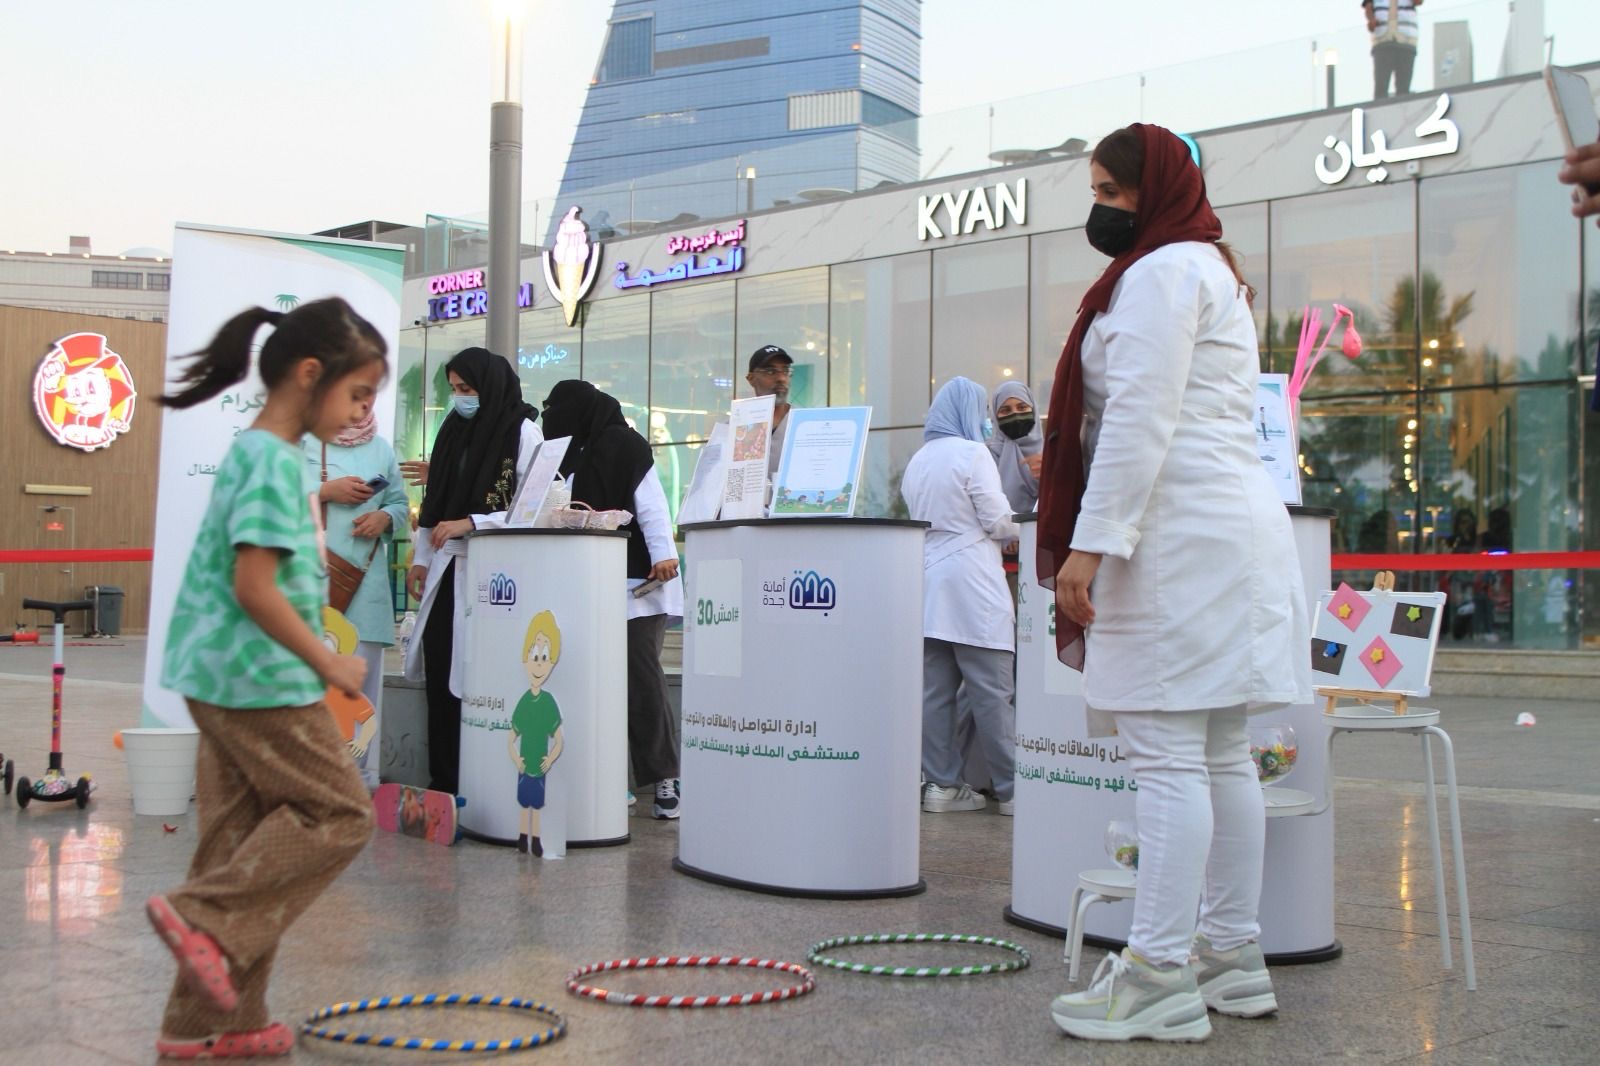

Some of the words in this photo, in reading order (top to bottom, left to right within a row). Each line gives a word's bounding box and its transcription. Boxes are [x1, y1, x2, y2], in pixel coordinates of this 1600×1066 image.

[1314, 93, 1459, 184] كيان
[917, 178, 1026, 241] KYAN
[667, 236, 689, 255] ركن
[690, 229, 719, 252] كريم
[615, 246, 745, 289] العاصمة
[428, 270, 484, 295] CORNER
[428, 294, 461, 321] ICE
[463, 282, 533, 315] CRM
[763, 577, 786, 593] أمانة
[763, 595, 785, 608] جدة
[707, 713, 737, 731] والعلاقات
[738, 716, 782, 735] التواصل
[785, 719, 817, 737] إدارة
[699, 737, 733, 755] ومستشفى
[735, 743, 750, 757] فهد
[752, 744, 784, 758] الملك
[787, 745, 860, 761] مستشفى
[1058, 740, 1106, 762] والعلاقات
[1046, 767, 1101, 790] ومستشفى
[1104, 775, 1125, 792] فهد
